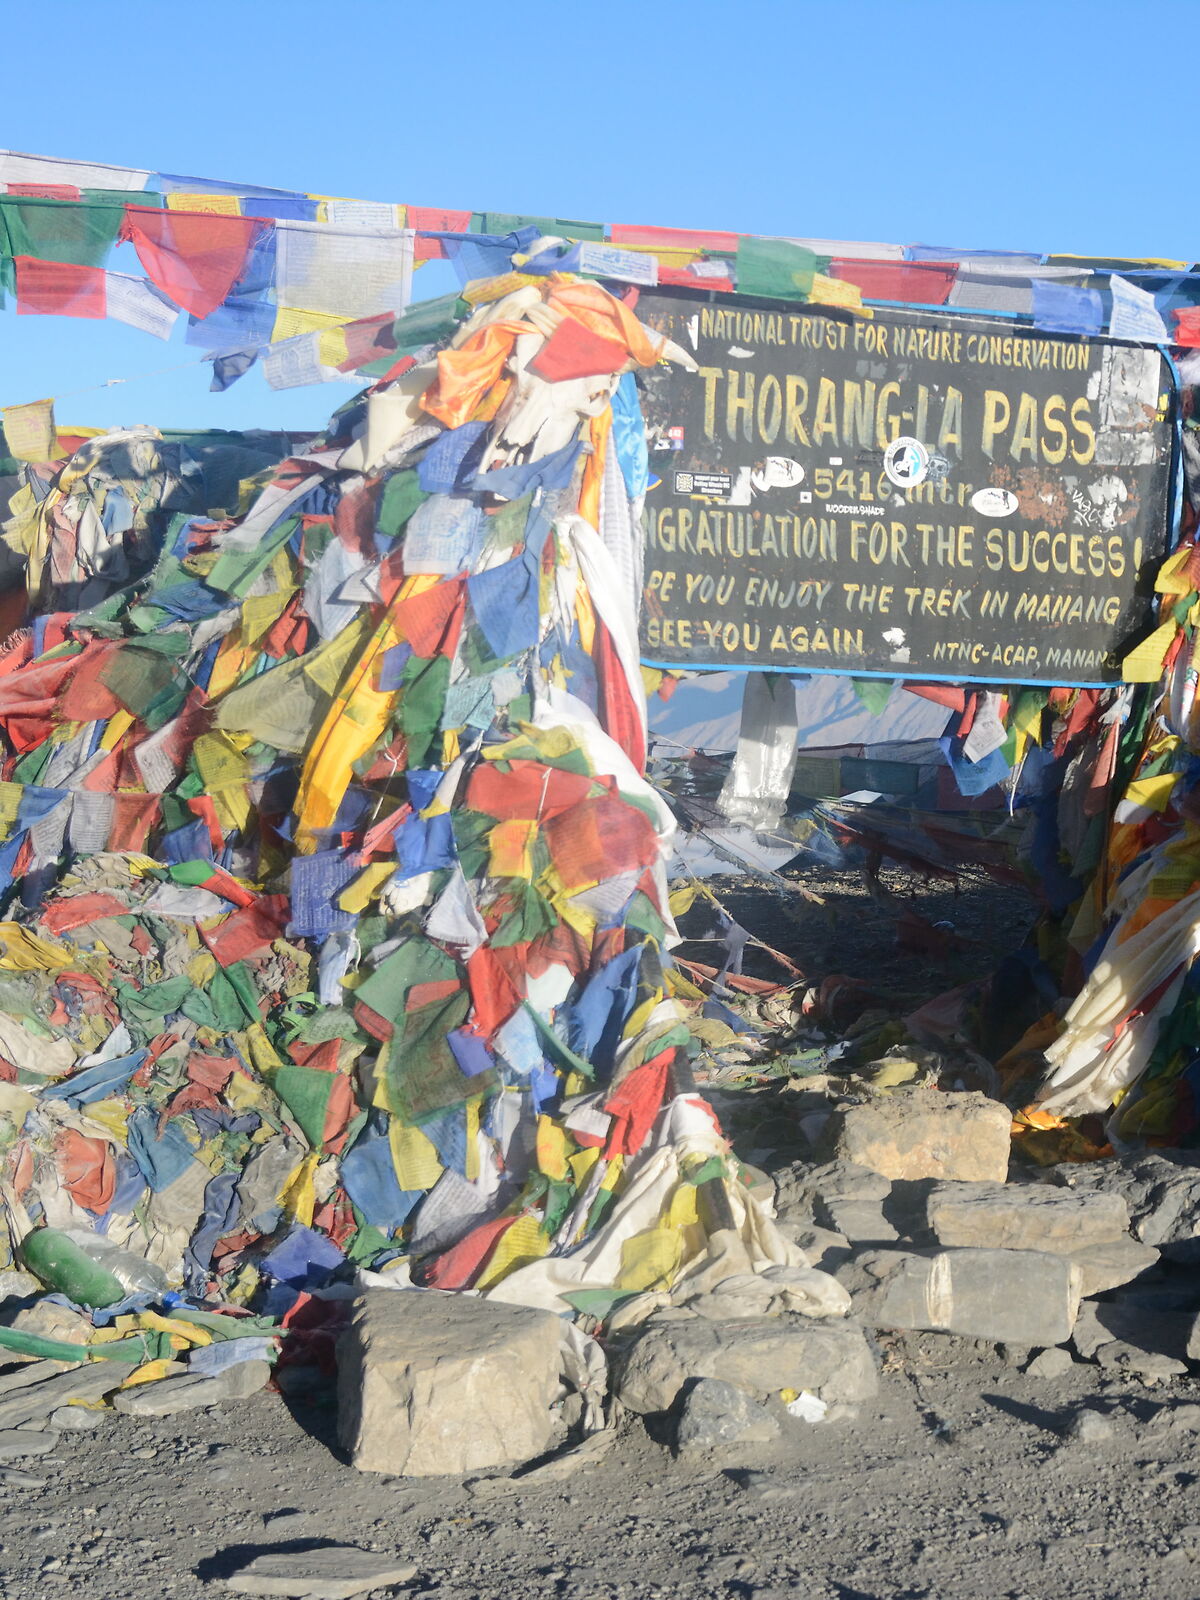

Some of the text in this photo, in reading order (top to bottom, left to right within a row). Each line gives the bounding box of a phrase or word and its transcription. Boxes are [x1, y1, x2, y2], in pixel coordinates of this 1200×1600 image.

[702, 307, 1089, 371] NATIONAL TRUST FOR NATURE CONSERVATION
[981, 389, 1096, 465] PASS
[814, 468, 892, 501] 5416
[904, 476, 973, 507] mtr
[850, 519, 911, 568] FOR
[916, 524, 975, 568] THE
[686, 573, 735, 606] YOU
[744, 576, 832, 612] ENJOY
[843, 583, 894, 614] THE
[905, 587, 971, 620] TREK
[980, 590, 1009, 619] IN
[1014, 592, 1120, 626] MANANG
[648, 618, 864, 656] SEE YOU AGAIN
